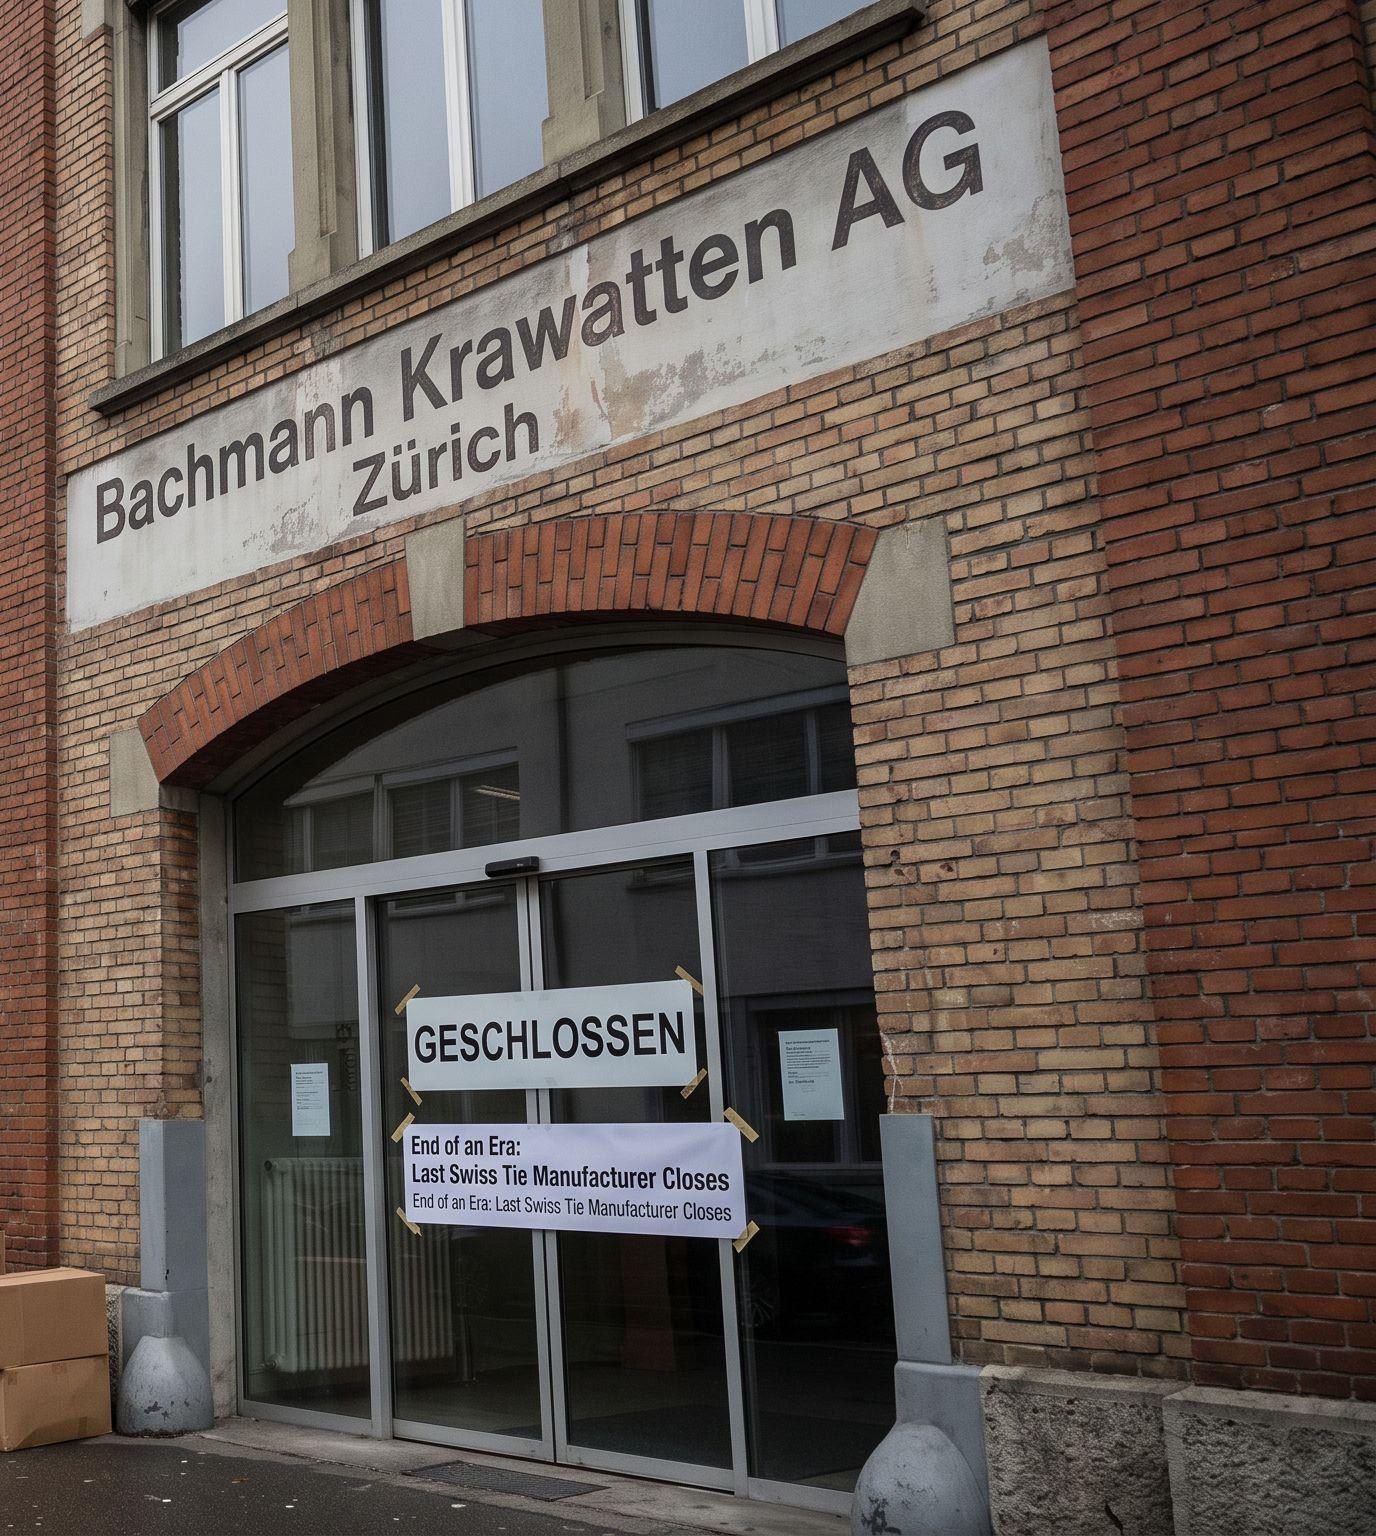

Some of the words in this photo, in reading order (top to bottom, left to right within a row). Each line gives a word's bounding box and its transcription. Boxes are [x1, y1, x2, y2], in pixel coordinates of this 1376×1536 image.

[96, 385, 375, 545] Bachmann
[400, 208, 797, 423] Krawatten
[830, 110, 985, 252] AG
[352, 403, 540, 517] Zürich
[414, 1011, 686, 1064] GESCHLOSSEN
[411, 1135, 440, 1156] End
[444, 1135, 460, 1156] of
[464, 1140, 484, 1156] an
[489, 1136, 521, 1156] Era:
[411, 1163, 445, 1184] Last
[449, 1163, 498, 1186] Swiss
[501, 1164, 528, 1186] Tie
[532, 1165, 657, 1190] Manufacturer
[662, 1166, 730, 1192] Closes
[412, 1192, 434, 1209] End
[437, 1193, 449, 1210] of
[451, 1197, 466, 1210] an
[469, 1194, 492, 1212] Era:
[495, 1195, 521, 1213] Last
[524, 1196, 561, 1214] Swiss
[564, 1197, 585, 1215] Tie
[588, 1198, 679, 1220] Manufacturer
[683, 1201, 732, 1222] Closes
